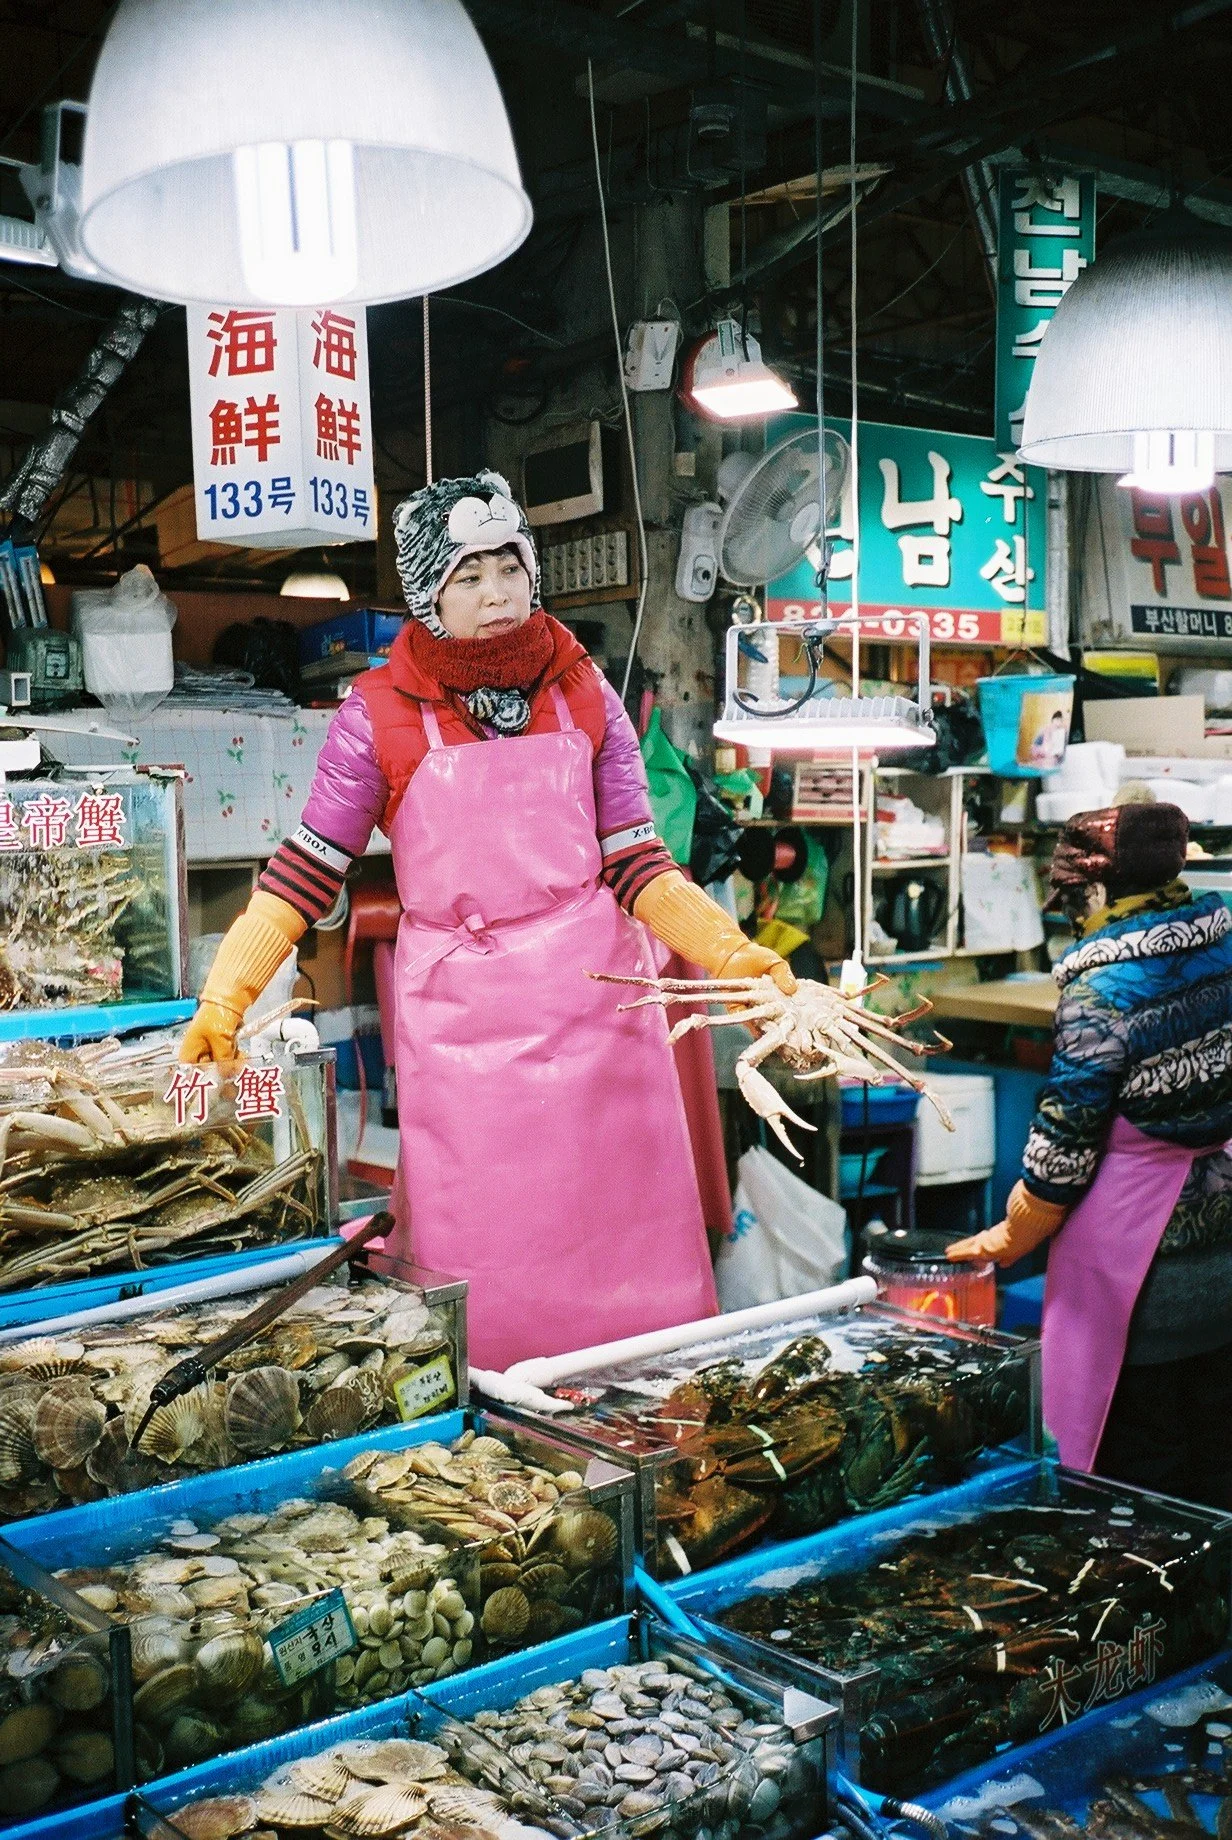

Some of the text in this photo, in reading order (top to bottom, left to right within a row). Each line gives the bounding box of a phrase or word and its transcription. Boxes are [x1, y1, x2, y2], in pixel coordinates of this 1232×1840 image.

[206, 310, 281, 466] 海鮮
[310, 309, 362, 466] 海鮮
[204, 476, 296, 521] 133号
[309, 475, 371, 527] 133号
[1145, 607, 1218, 636] 부산할머니
[1039, 1617, 1167, 1733] 大龙虾
